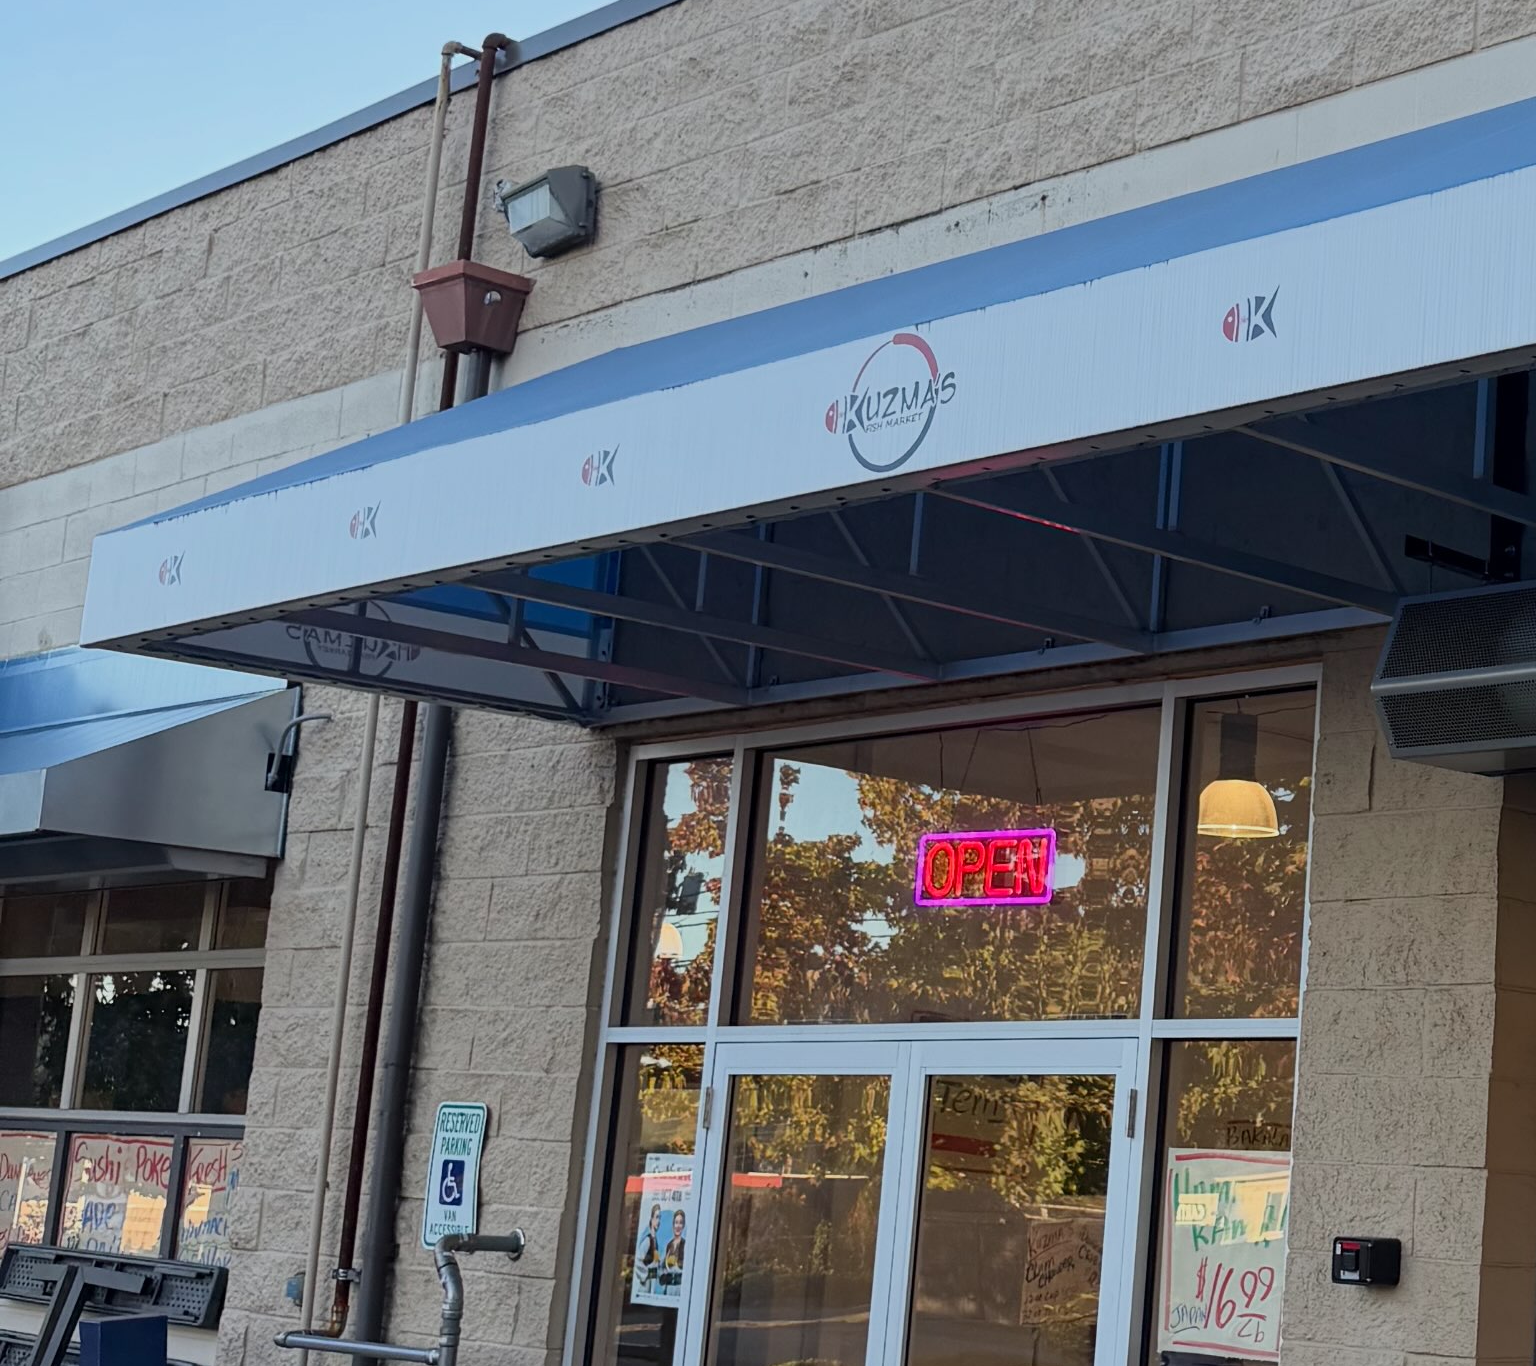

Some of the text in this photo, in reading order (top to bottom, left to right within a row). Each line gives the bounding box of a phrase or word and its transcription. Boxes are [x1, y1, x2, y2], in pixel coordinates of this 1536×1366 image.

[842, 371, 957, 434] KUZMA'S
[865, 411, 924, 433] FISH MARKET
[924, 837, 1048, 898] OPEN
[439, 1111, 481, 1134] RESERVED
[440, 1136, 473, 1156] PARKING
[75, 1140, 122, 1185] Sushi
[443, 1210, 457, 1222] VAN
[429, 1223, 469, 1236] ACCESSIBLE
[1170, 1303, 1209, 1329] JAPAN
